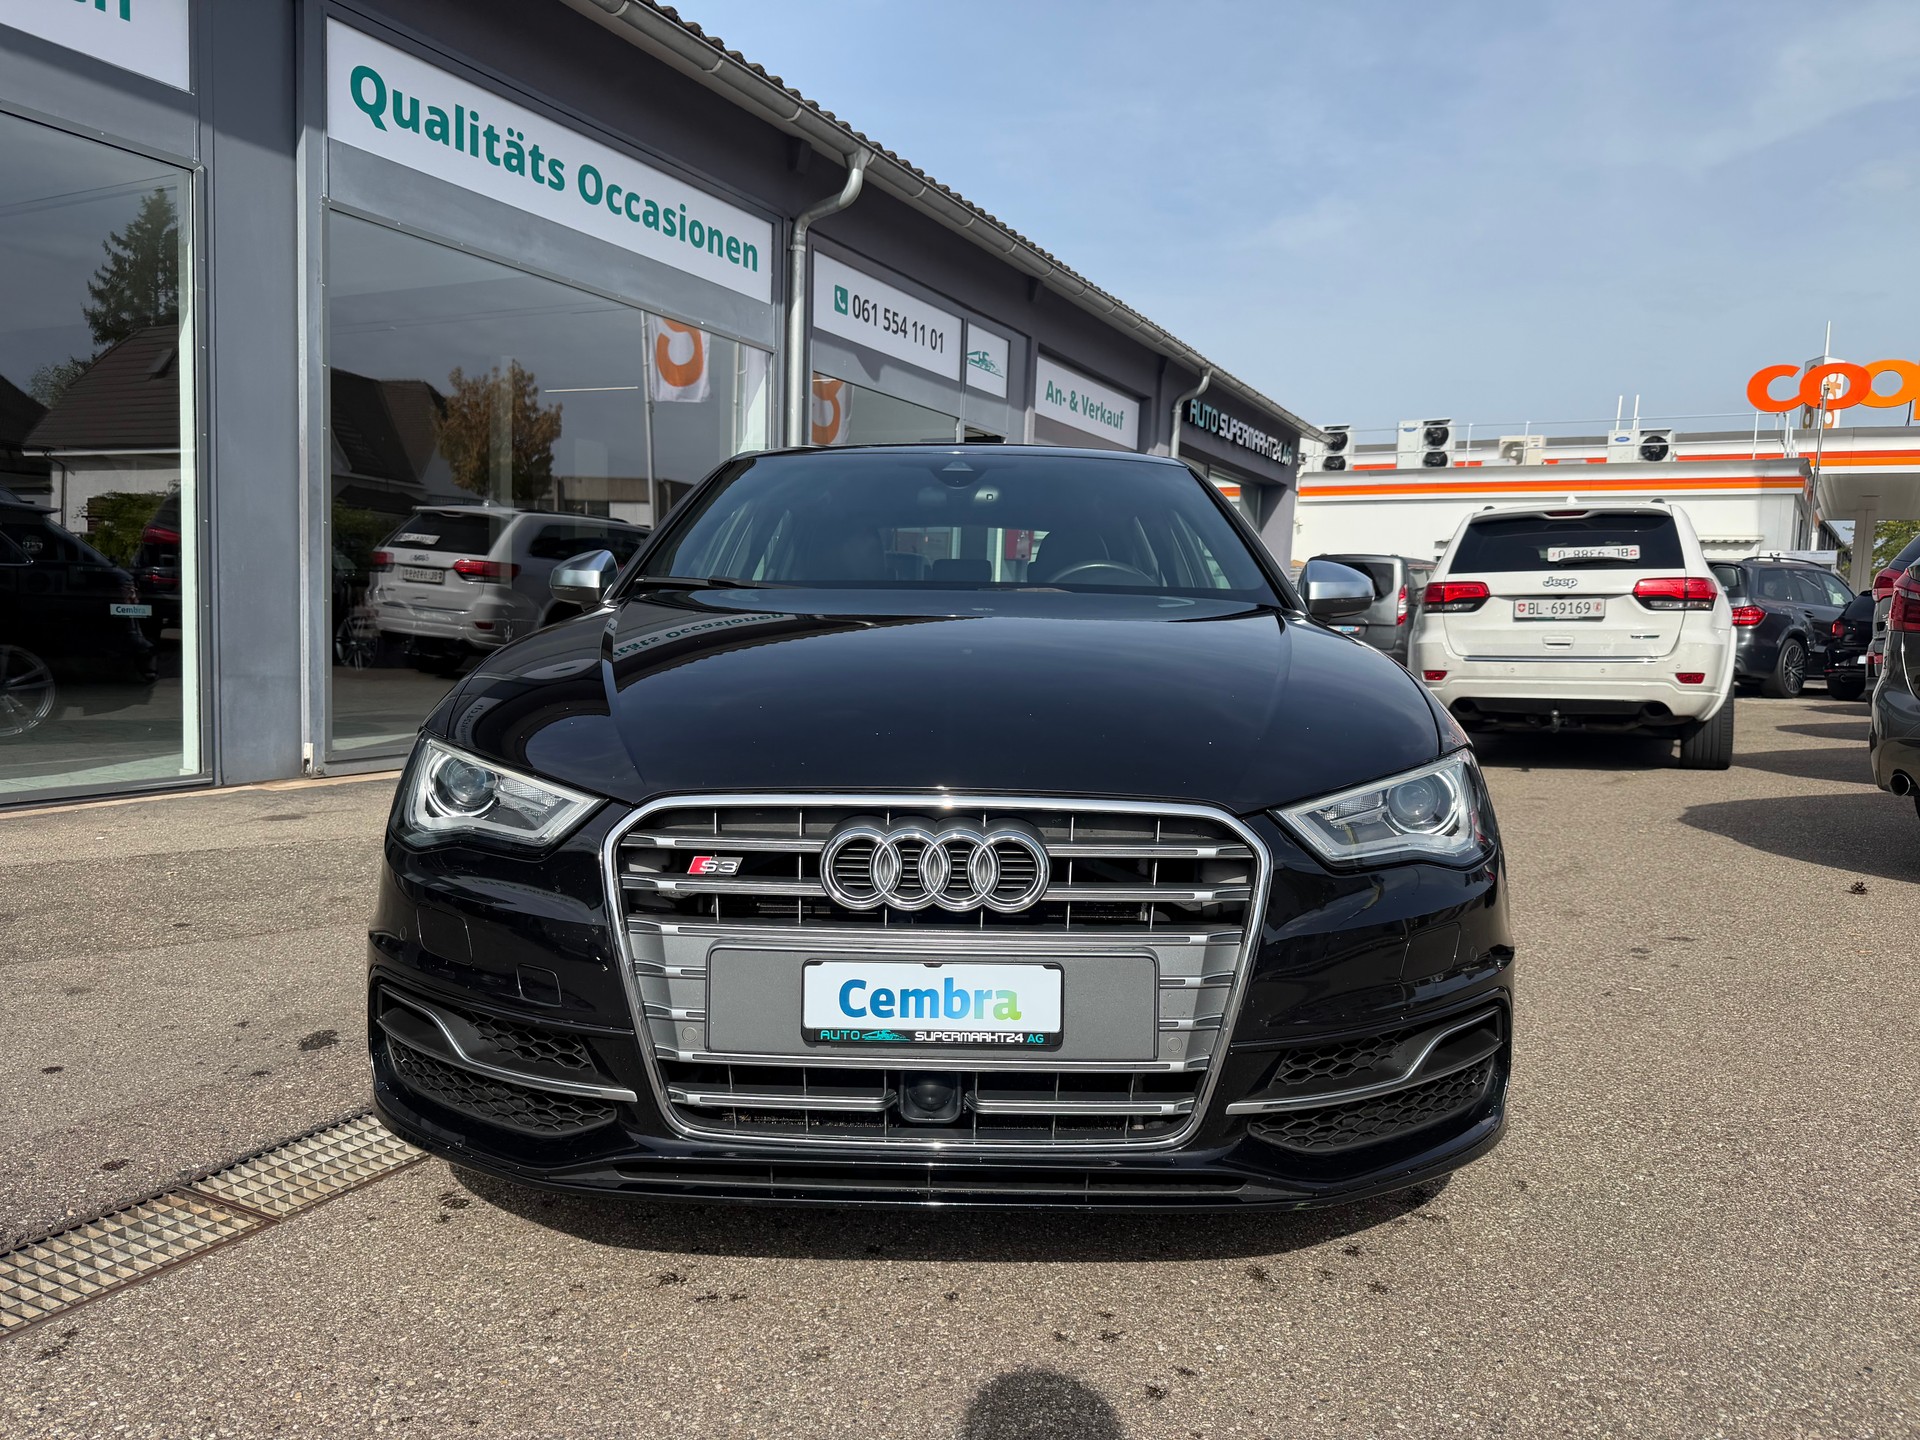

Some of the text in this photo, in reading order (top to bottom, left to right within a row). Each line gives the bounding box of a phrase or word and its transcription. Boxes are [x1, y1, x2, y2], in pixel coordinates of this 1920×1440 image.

[350, 65, 759, 273] Qualitäts Occasionen
[852, 294, 943, 354] 061 554 11 01
[1045, 380, 1124, 431] An- & Verkauf
[1746, 359, 1920, 421] coo
[1190, 398, 1292, 466] AUTO SUPERMARKT24 AG
[1543, 576, 1578, 588] Jeep
[115, 606, 147, 614] Cembra
[699, 860, 738, 873] S3
[839, 977, 1022, 1021] Cembra
[820, 1030, 1044, 1044] AUTO SUPERMARKT24 AG
